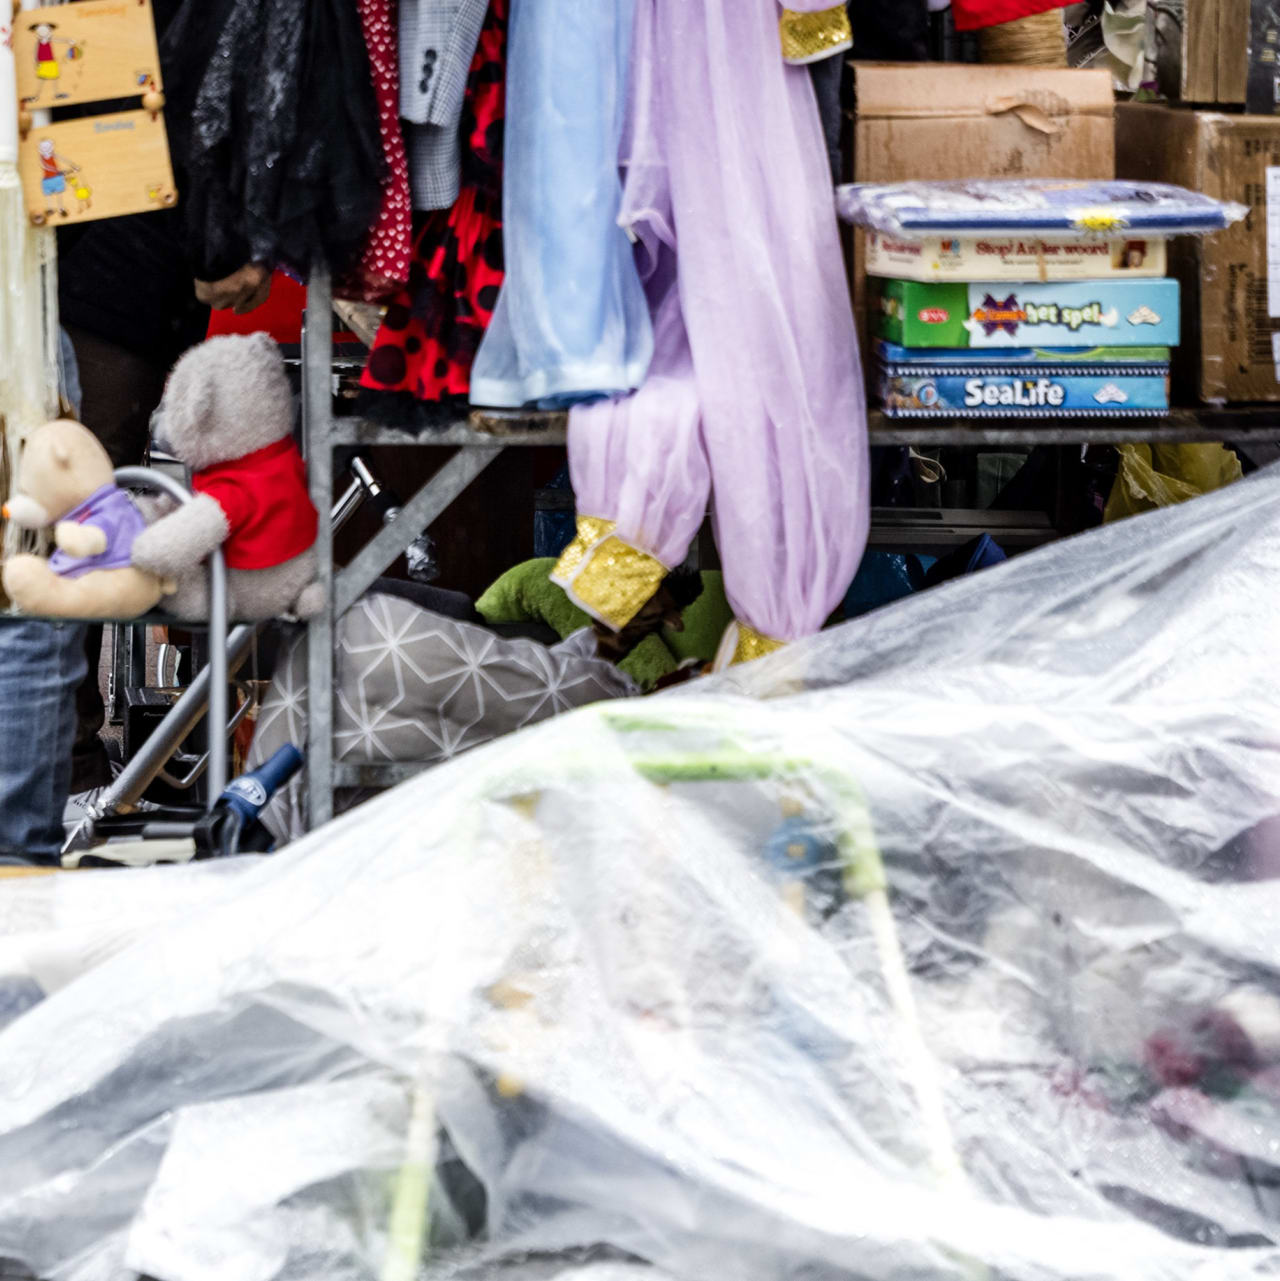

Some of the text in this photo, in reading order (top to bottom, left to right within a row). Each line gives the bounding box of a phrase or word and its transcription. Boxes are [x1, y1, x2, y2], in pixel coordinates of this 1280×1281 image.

[1024, 302, 1059, 325] het
[1061, 302, 1102, 330] spel
[965, 378, 1065, 407] SeaLife
